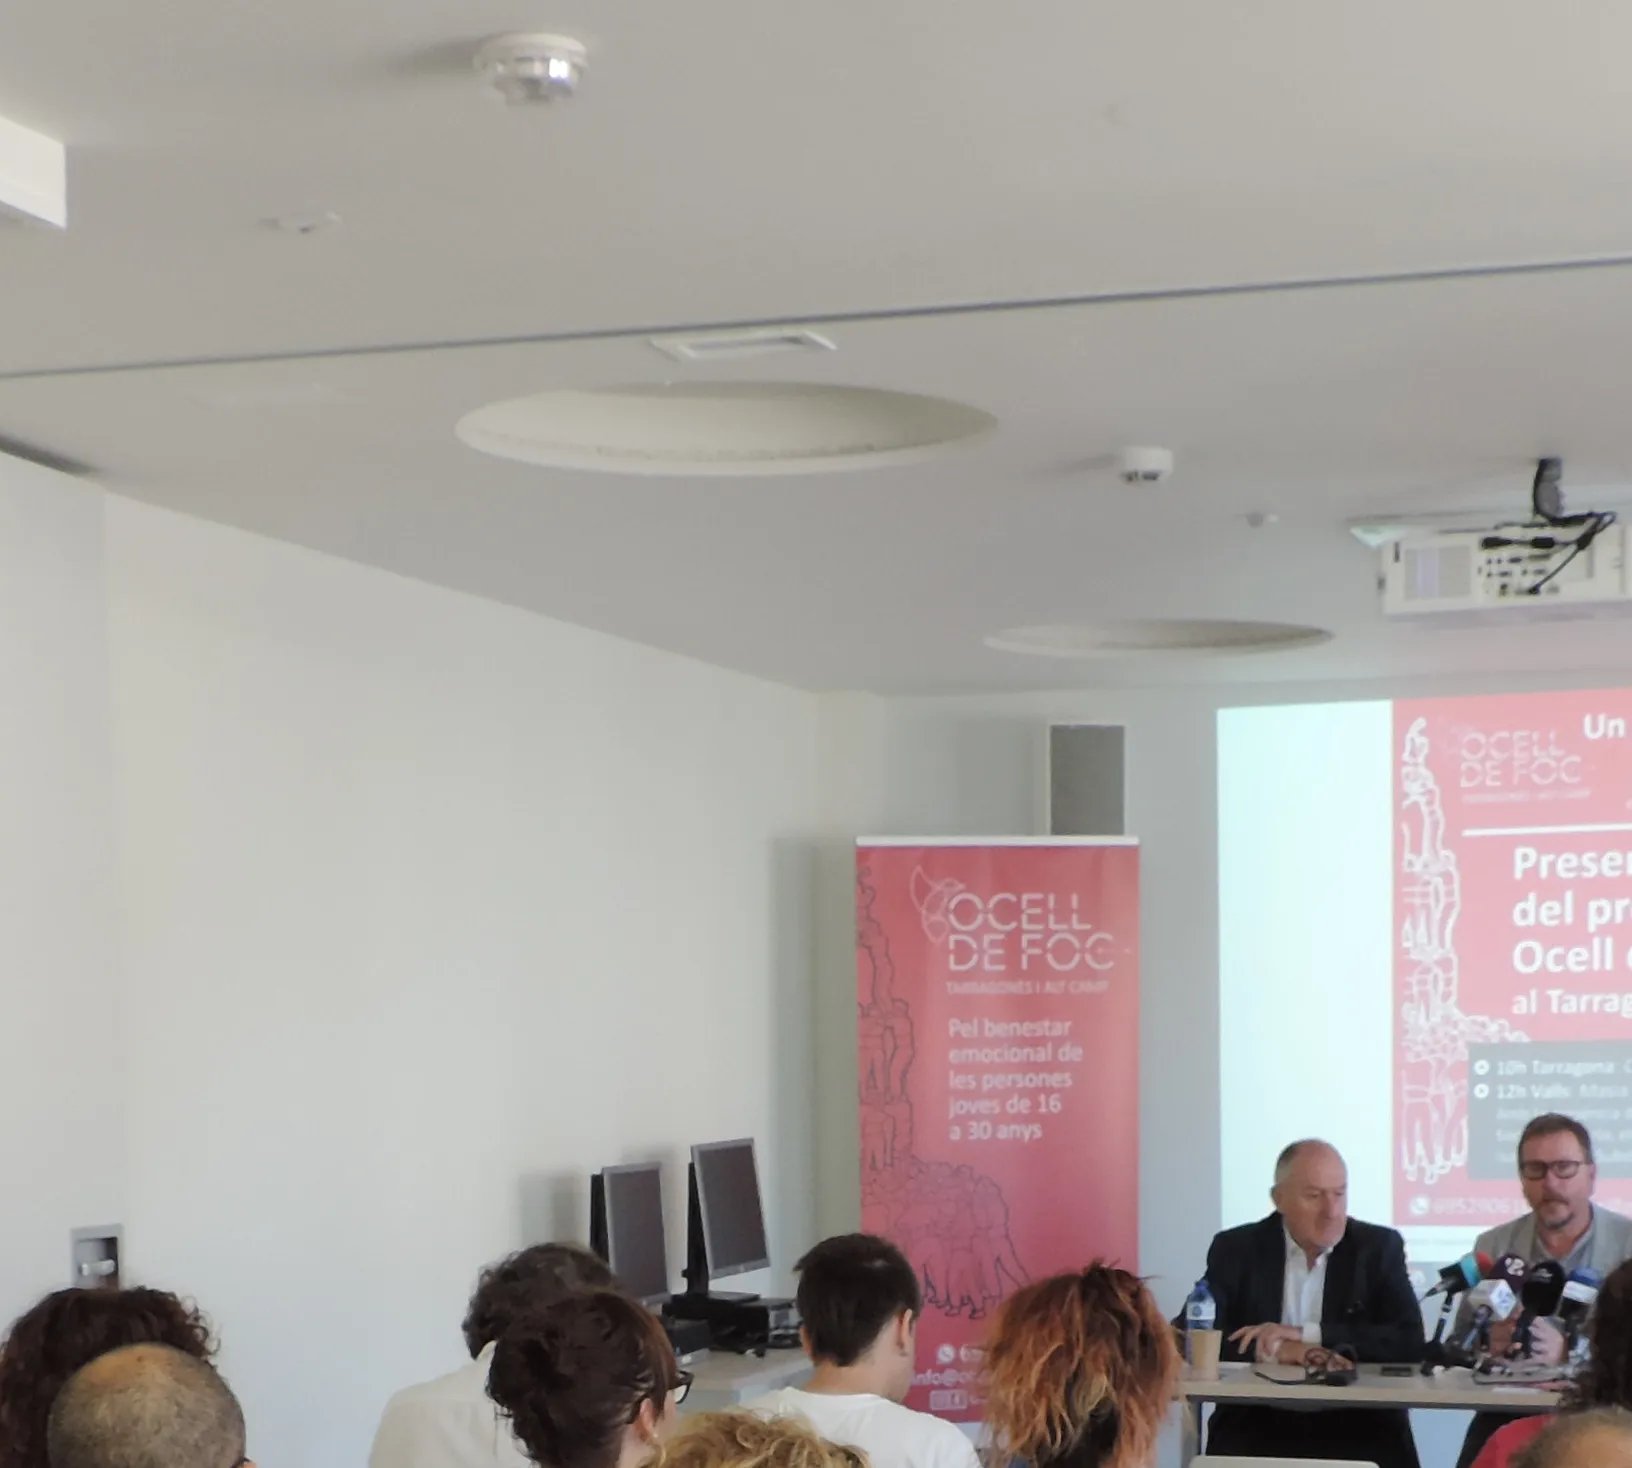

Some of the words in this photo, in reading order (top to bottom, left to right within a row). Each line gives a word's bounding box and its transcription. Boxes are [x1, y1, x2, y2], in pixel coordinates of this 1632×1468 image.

[1583, 712, 1625, 740] Un
[1460, 729, 1567, 761] OCELL
[1459, 759, 1503, 788] DE
[1512, 753, 1583, 786] FOC
[947, 892, 1093, 932] OCELL
[1512, 889, 1575, 928] del
[948, 932, 1007, 971] DE
[1020, 931, 1116, 971] FOC
[1512, 934, 1614, 973] Ocell
[1512, 988, 1537, 1014] al
[948, 1016, 979, 1039] Pel
[983, 1016, 1073, 1038] benestar
[948, 1041, 1053, 1065] emocional
[1057, 1041, 1084, 1062] de
[948, 1069, 977, 1090] les
[981, 1072, 1073, 1093] persones
[948, 1096, 1002, 1119] joves
[1005, 1092, 1033, 1114] de
[1037, 1092, 1063, 1115] 16
[948, 1123, 962, 1141] a
[966, 1120, 993, 1141] 30
[995, 1121, 1044, 1144] anys
